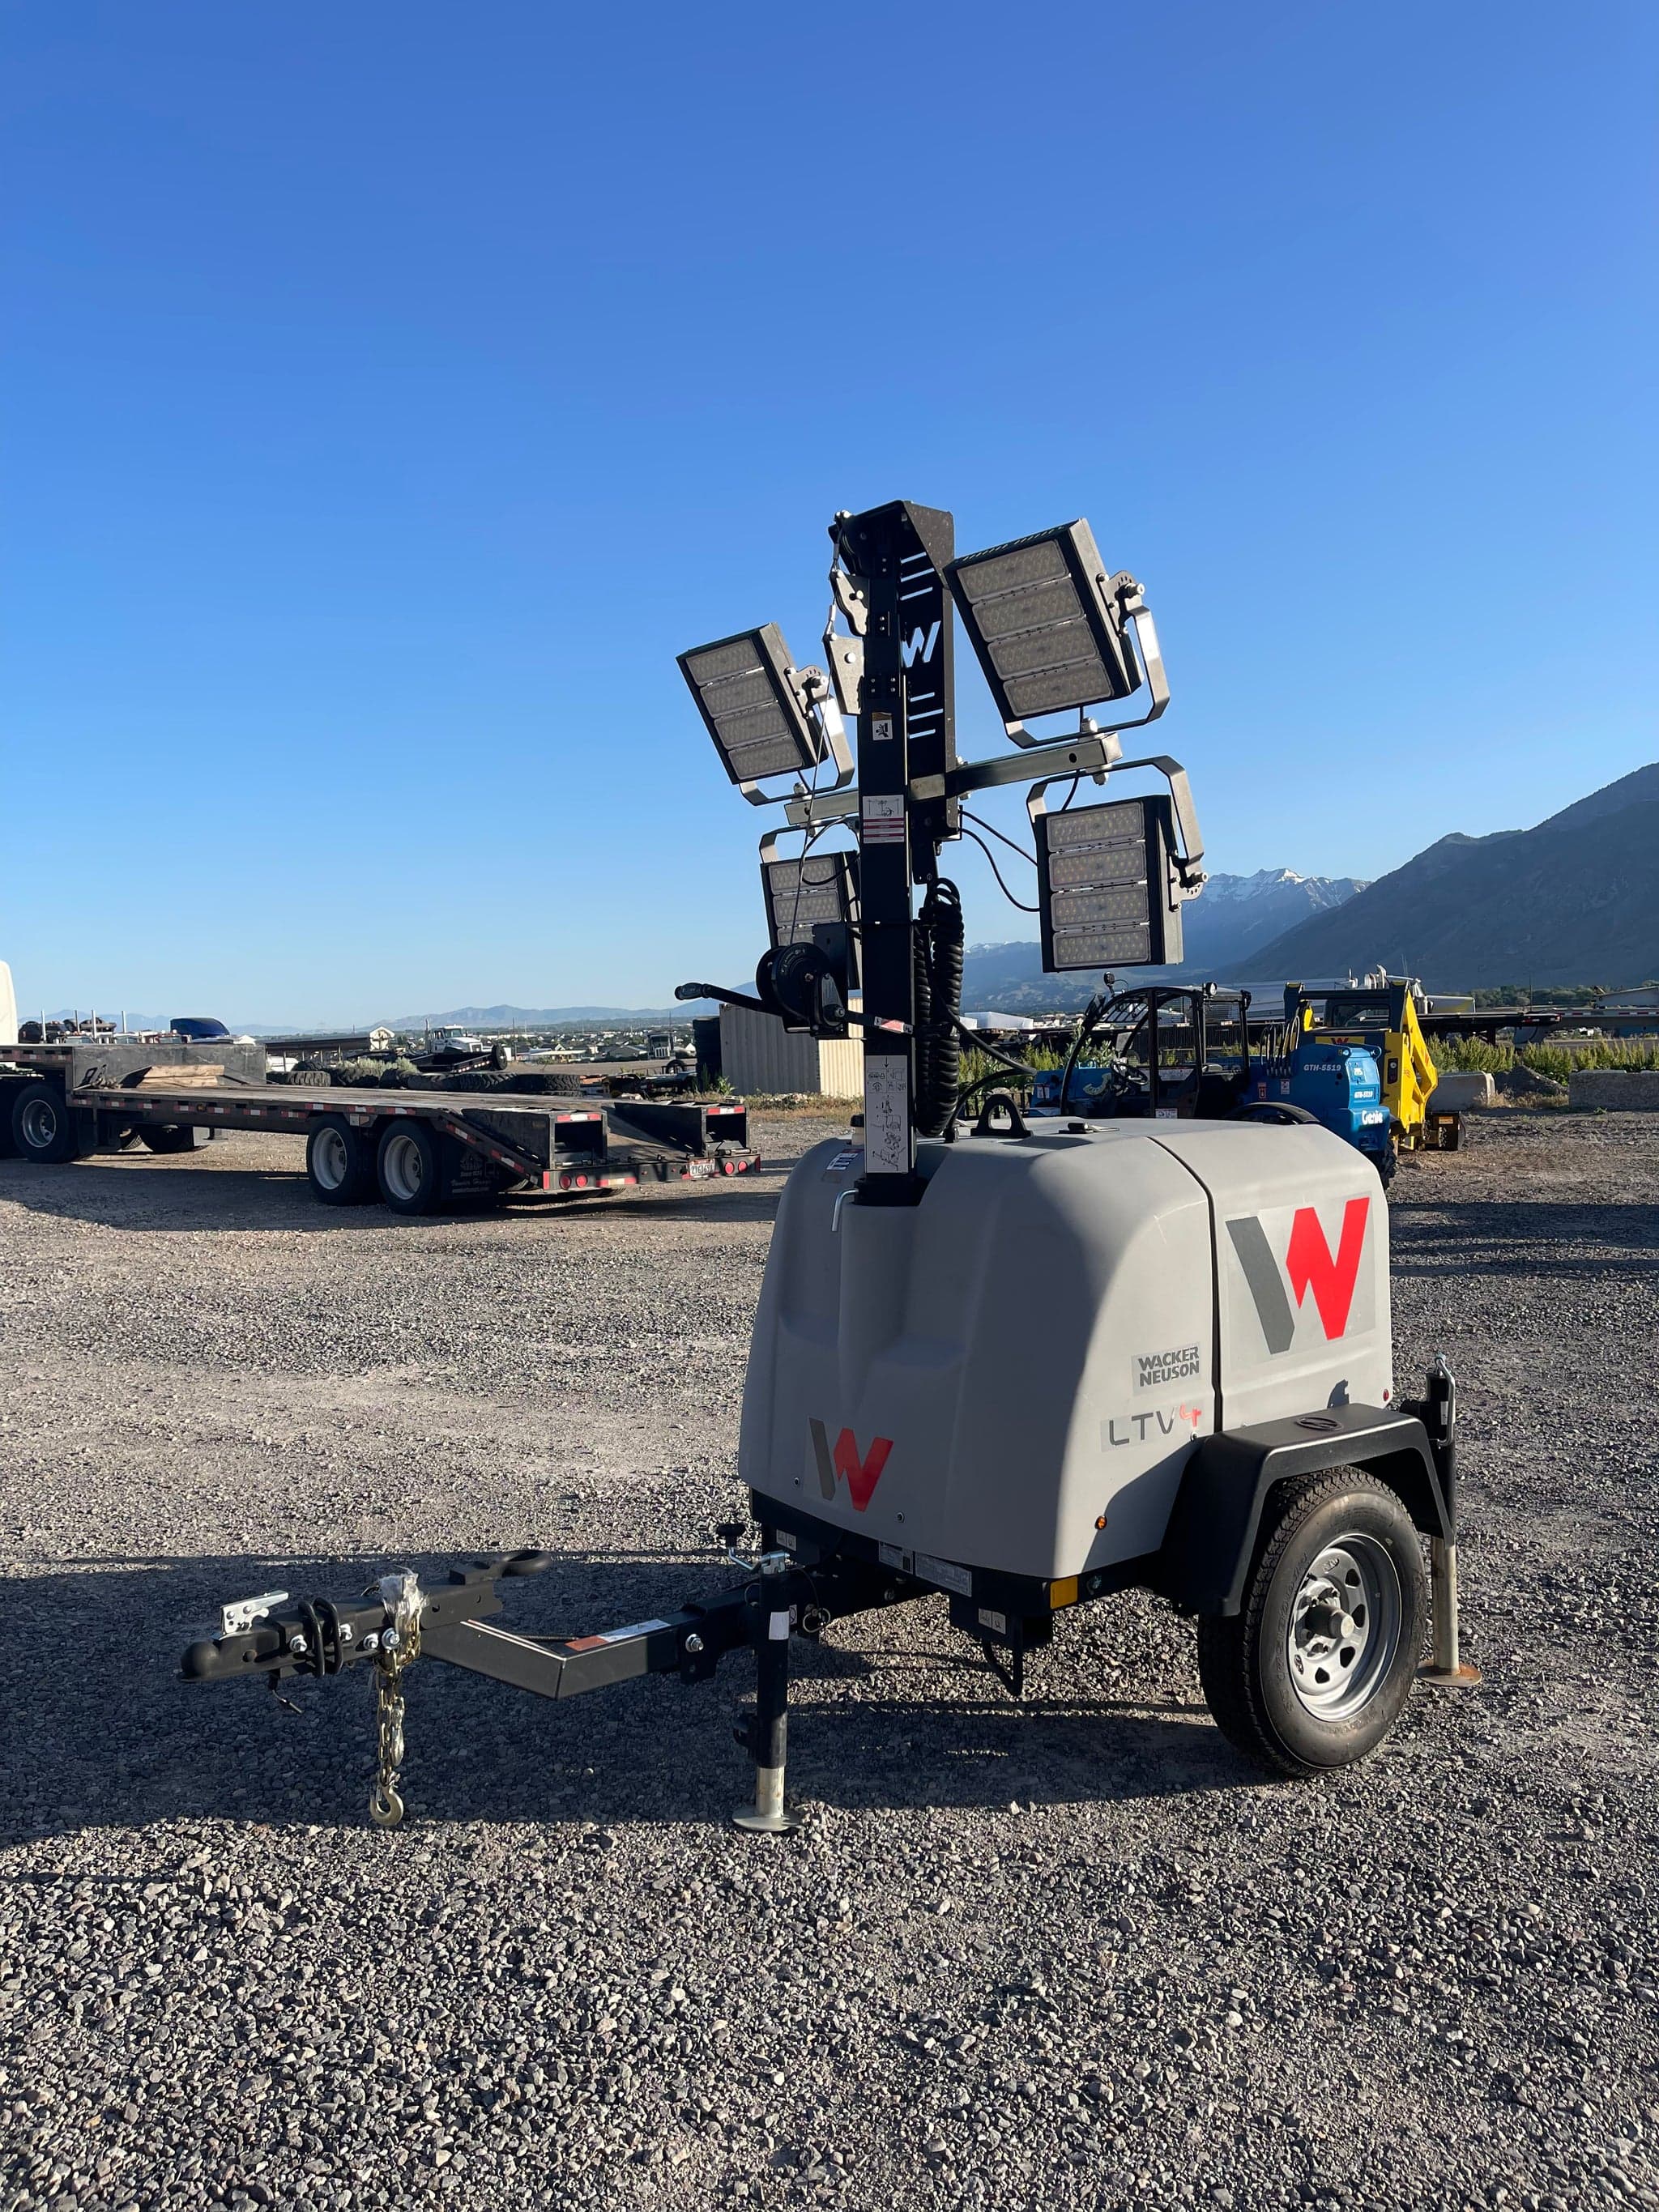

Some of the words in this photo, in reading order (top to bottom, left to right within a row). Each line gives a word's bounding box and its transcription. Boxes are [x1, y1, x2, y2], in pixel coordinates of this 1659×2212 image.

[1362, 1110, 1383, 1125] Genie
[1138, 1346, 1200, 1371] WACKER
[1140, 1361, 1200, 1387] NEUSON
